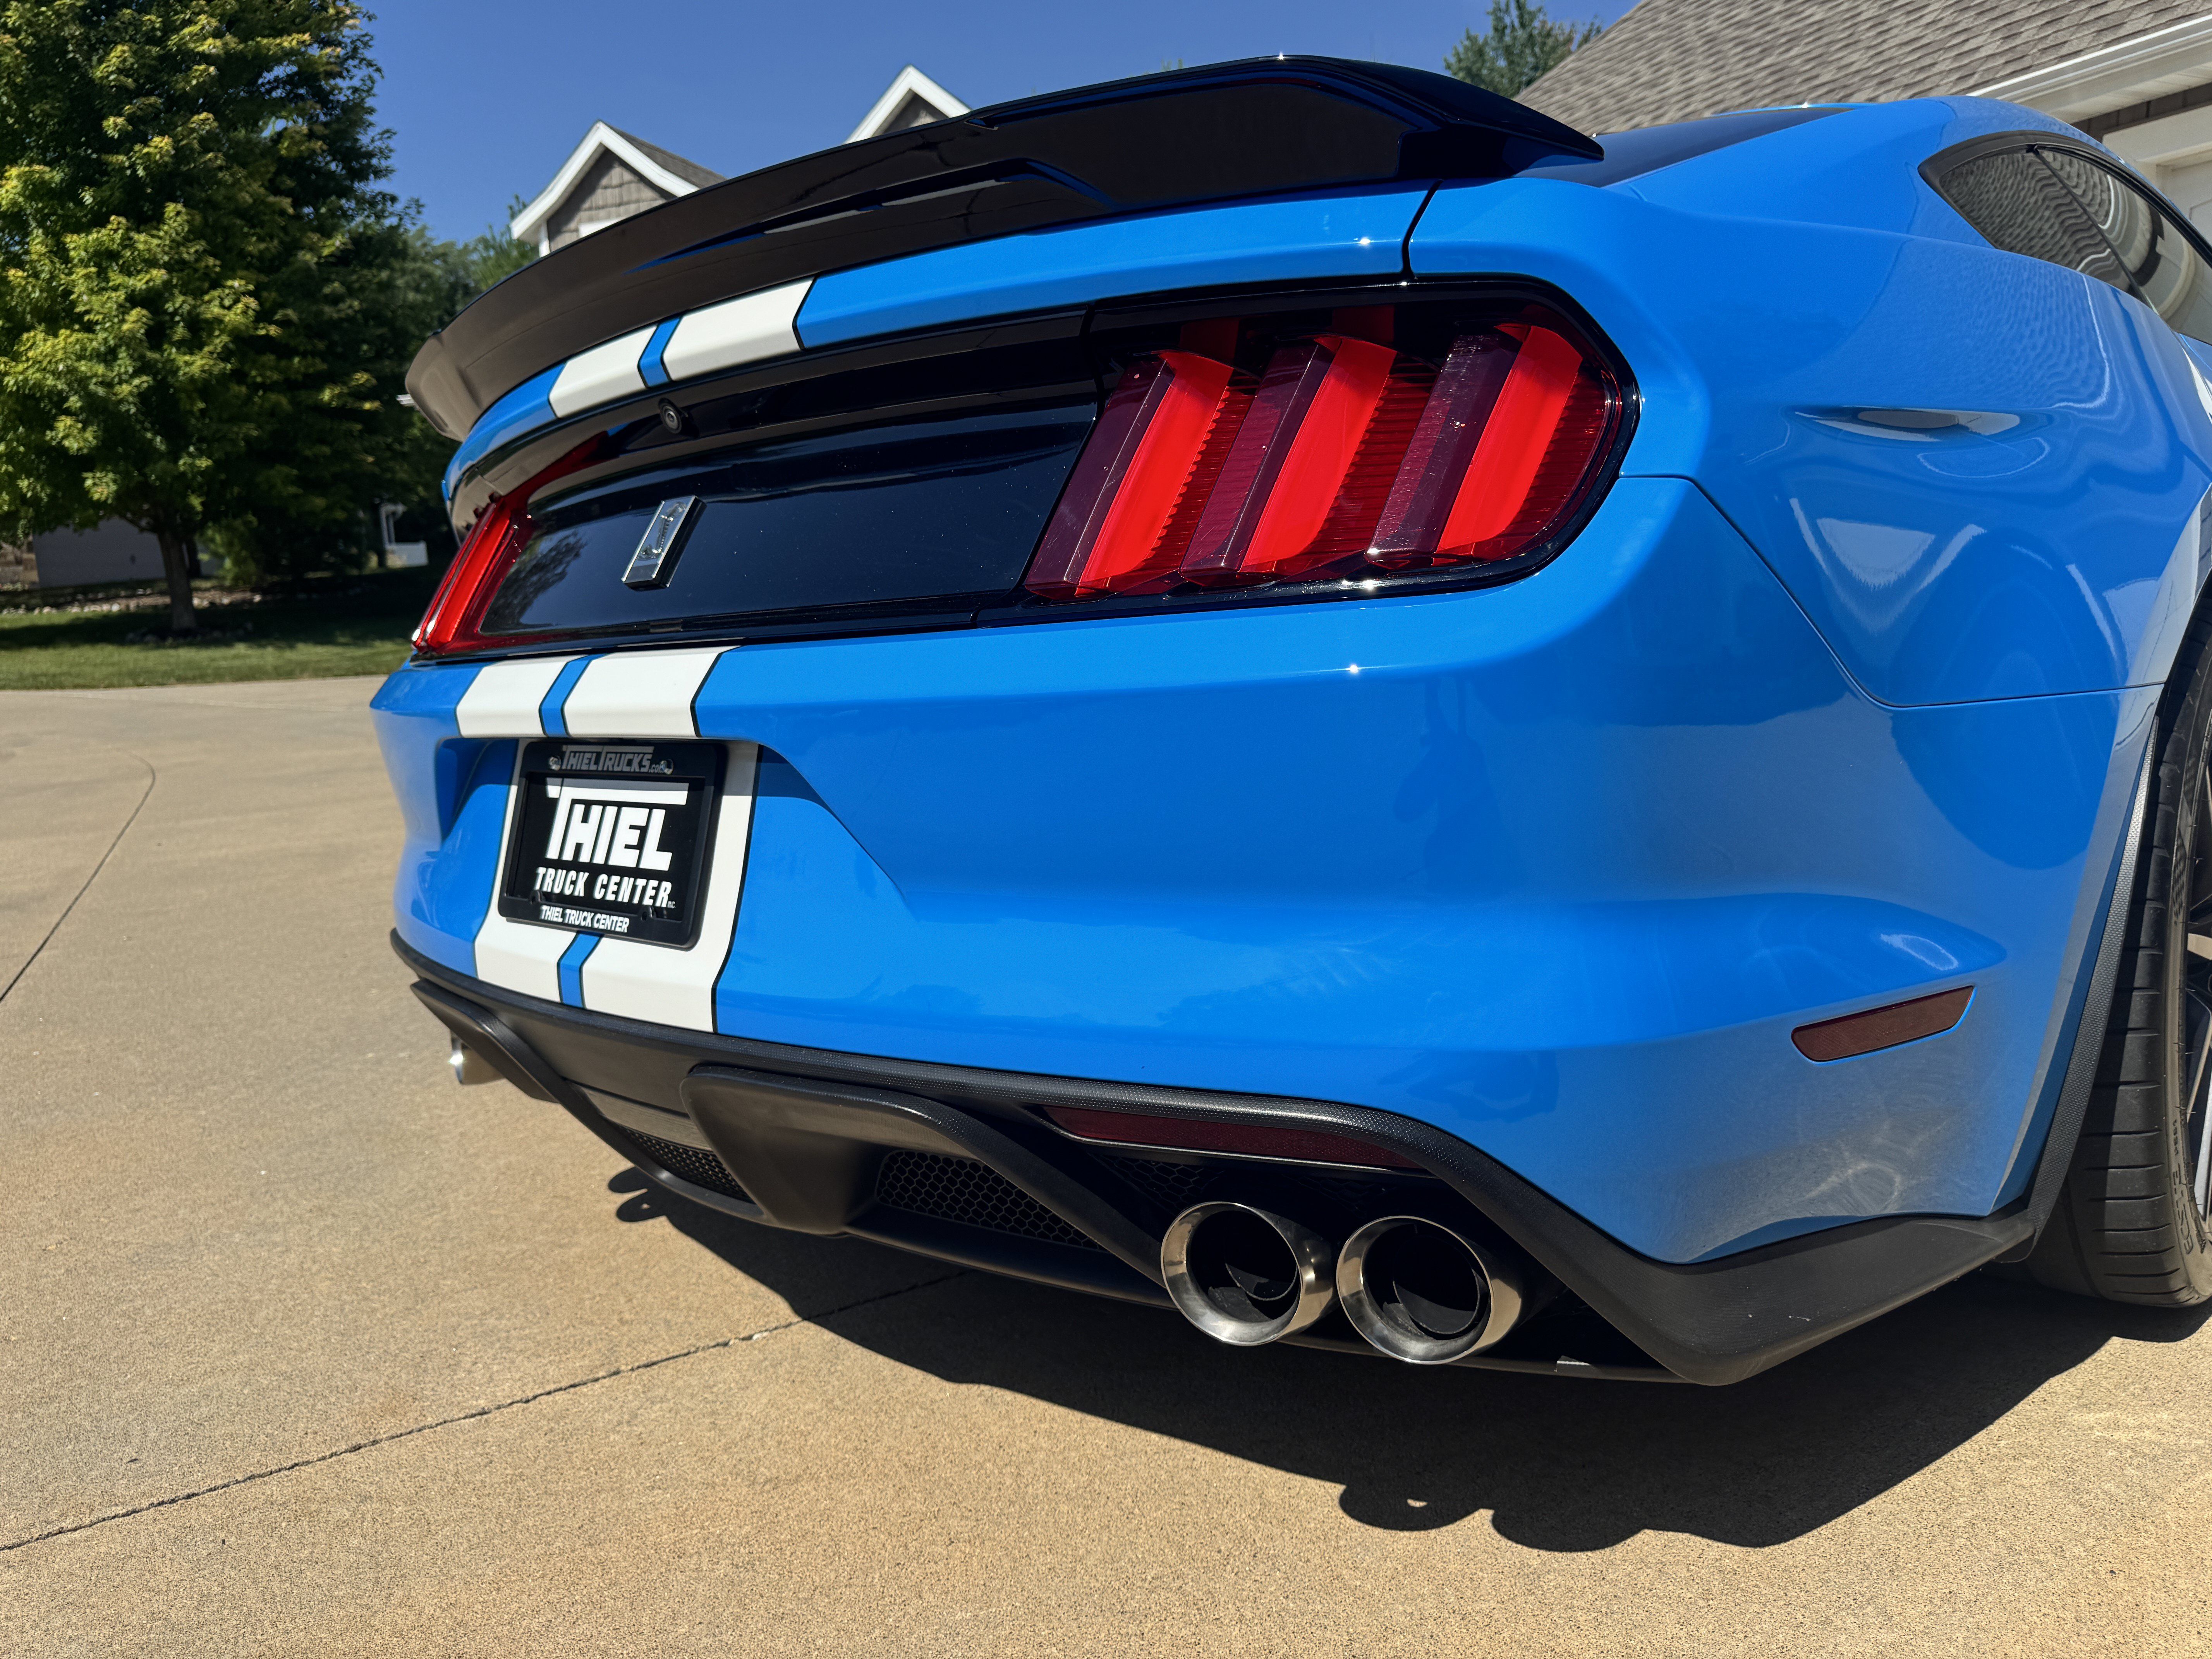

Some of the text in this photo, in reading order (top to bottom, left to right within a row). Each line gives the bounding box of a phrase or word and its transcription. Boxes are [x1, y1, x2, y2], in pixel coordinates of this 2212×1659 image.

[545, 777, 689, 871] THIEL
[534, 867, 589, 896] TRUCK
[593, 874, 672, 907] CENTER
[539, 905, 630, 933] THIEL TRUCK CENTER
